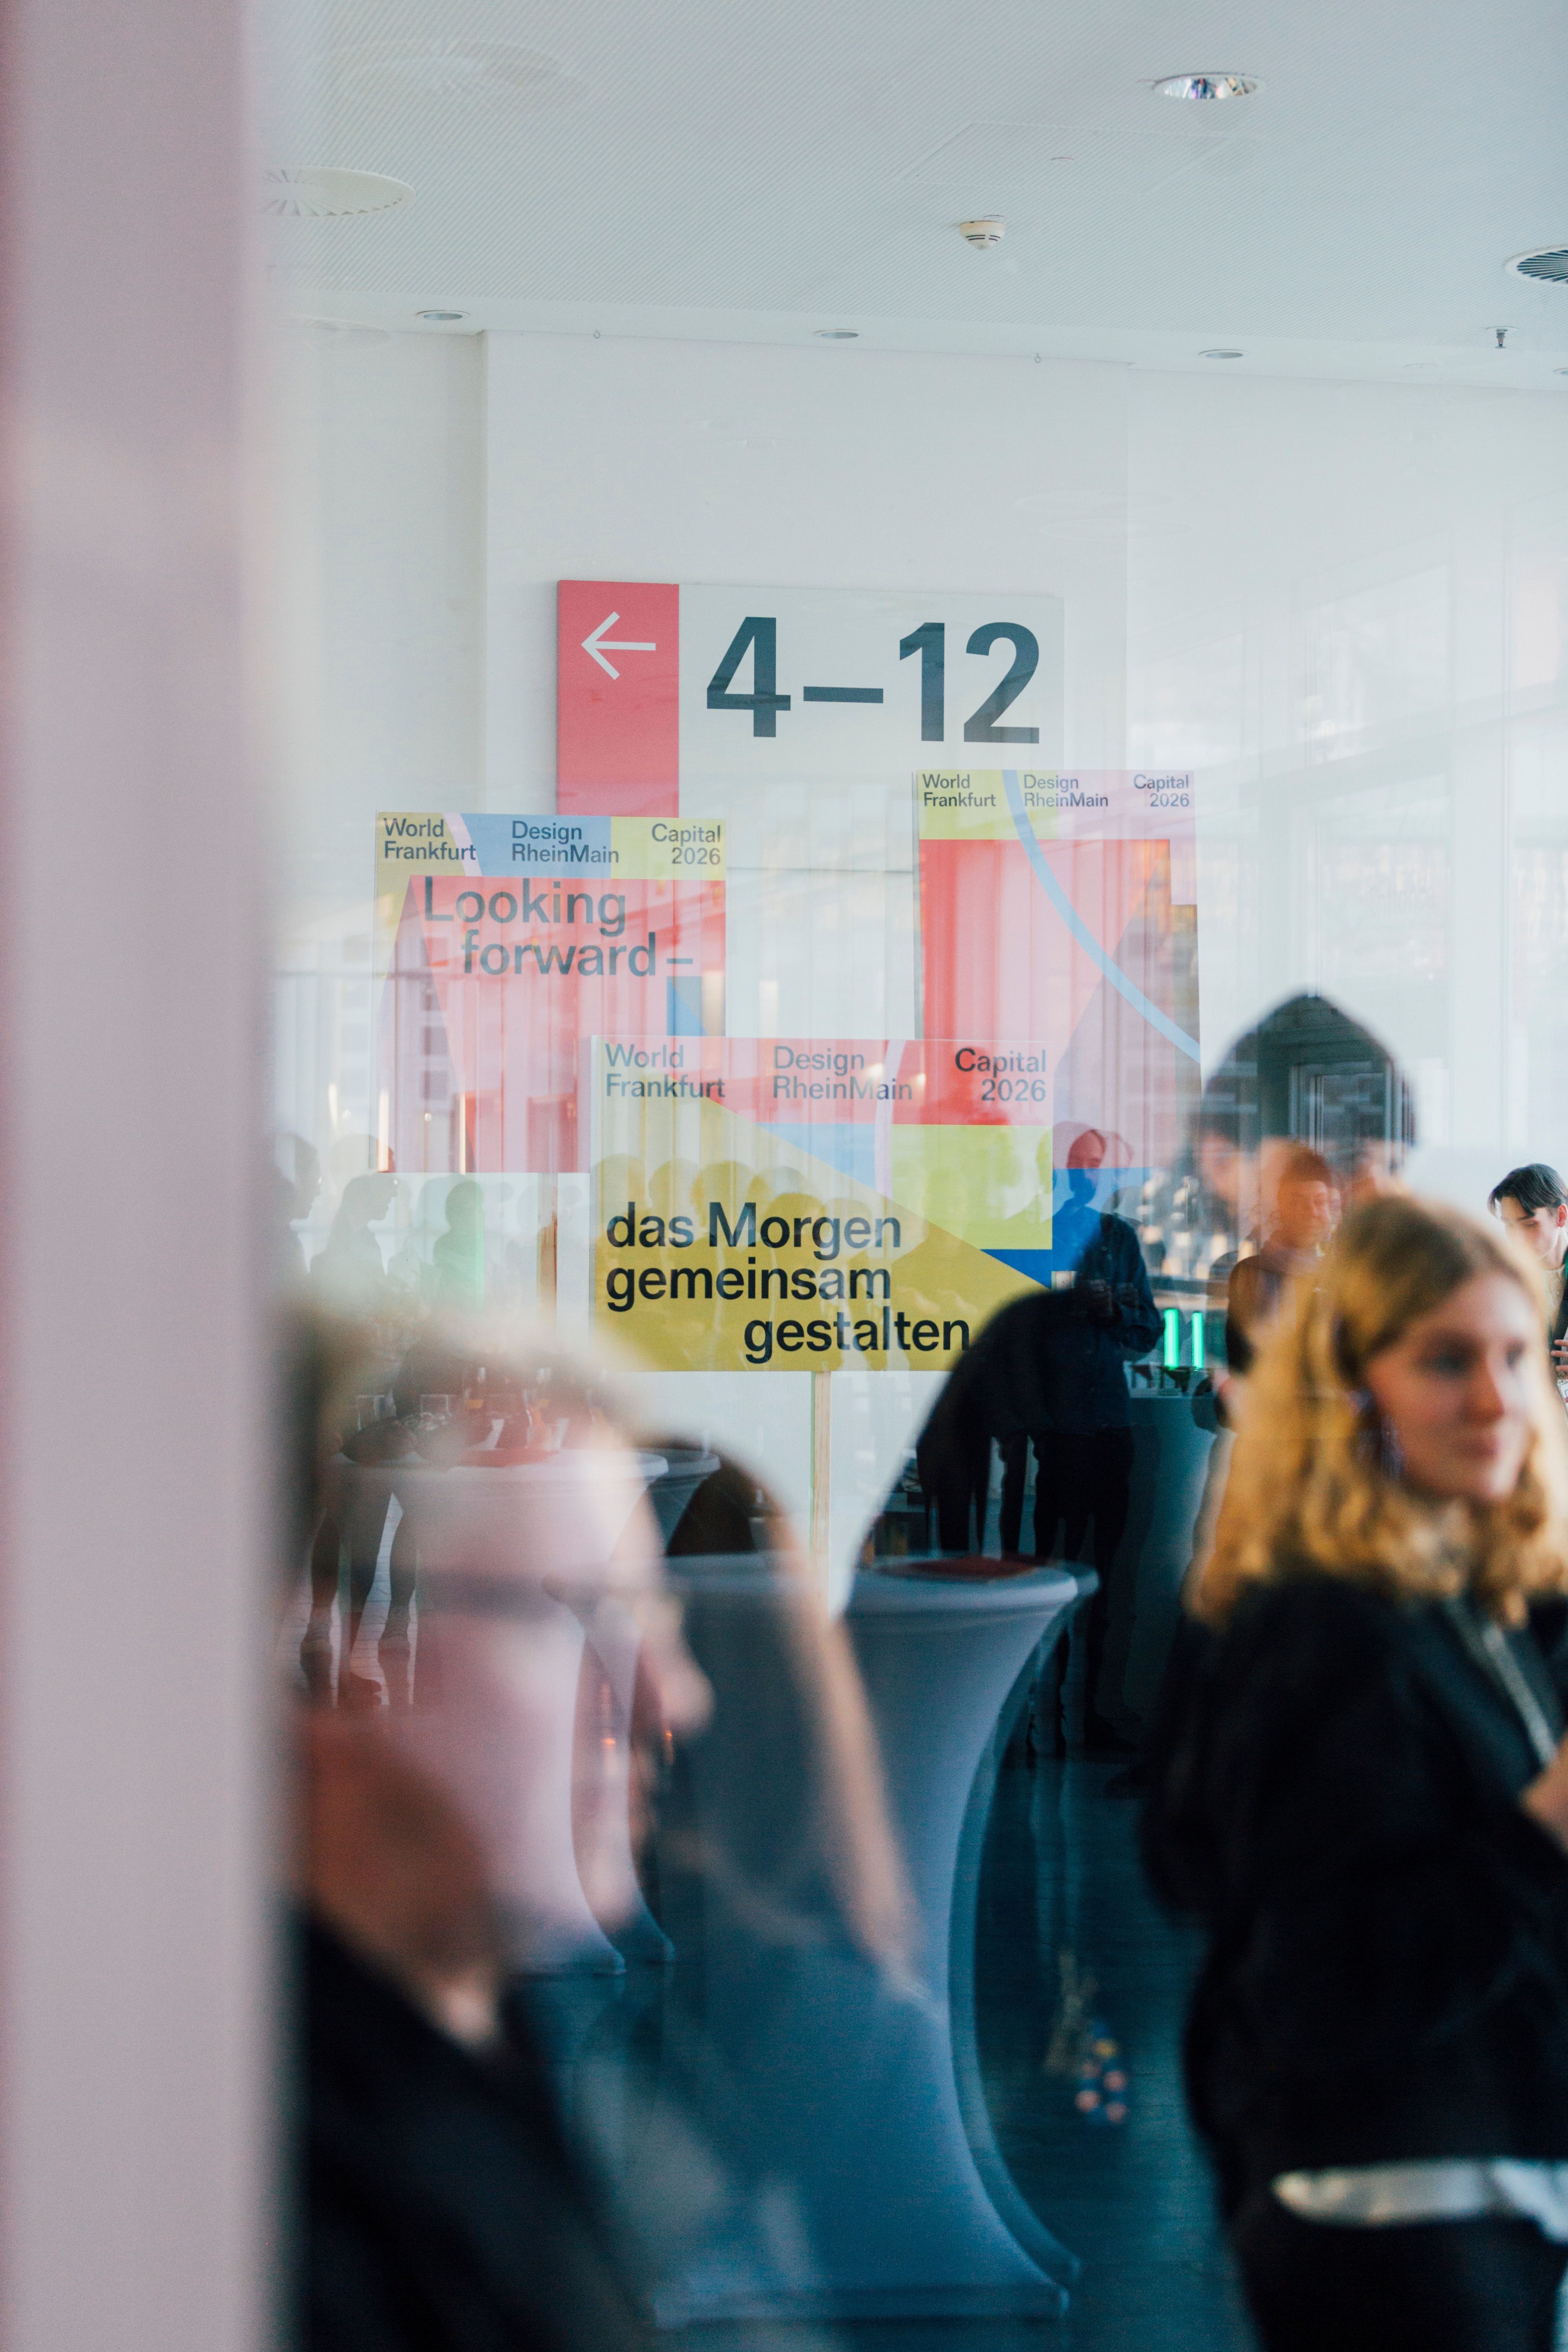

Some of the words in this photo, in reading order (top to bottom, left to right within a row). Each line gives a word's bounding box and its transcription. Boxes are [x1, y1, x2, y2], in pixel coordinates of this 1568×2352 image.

[923, 774, 970, 788] World
[1024, 775, 1078, 792] Design
[1134, 775, 1189, 793] Capital
[924, 792, 996, 807] Frankfurt
[1024, 793, 1108, 807] RheinMain
[1150, 793, 1189, 807] 2026
[383, 818, 443, 837] World
[512, 821, 582, 844] Design
[651, 824, 720, 846] Capital
[385, 840, 476, 860] Frankfurt
[512, 843, 618, 863] RheinMain
[672, 848, 720, 865] 2026
[425, 876, 626, 937] Looking
[605, 1044, 684, 1068] World
[774, 1046, 864, 1076] Design
[955, 1048, 1046, 1078] Capital
[606, 1074, 725, 1098] Frankfurt
[773, 1076, 912, 1100] RheinMain
[981, 1079, 1046, 1102] 2026
[607, 1202, 694, 1248] das
[709, 1202, 900, 1260] Morgen
[606, 1257, 890, 1312] gemeinsam
[744, 1306, 969, 1363] gestalten
